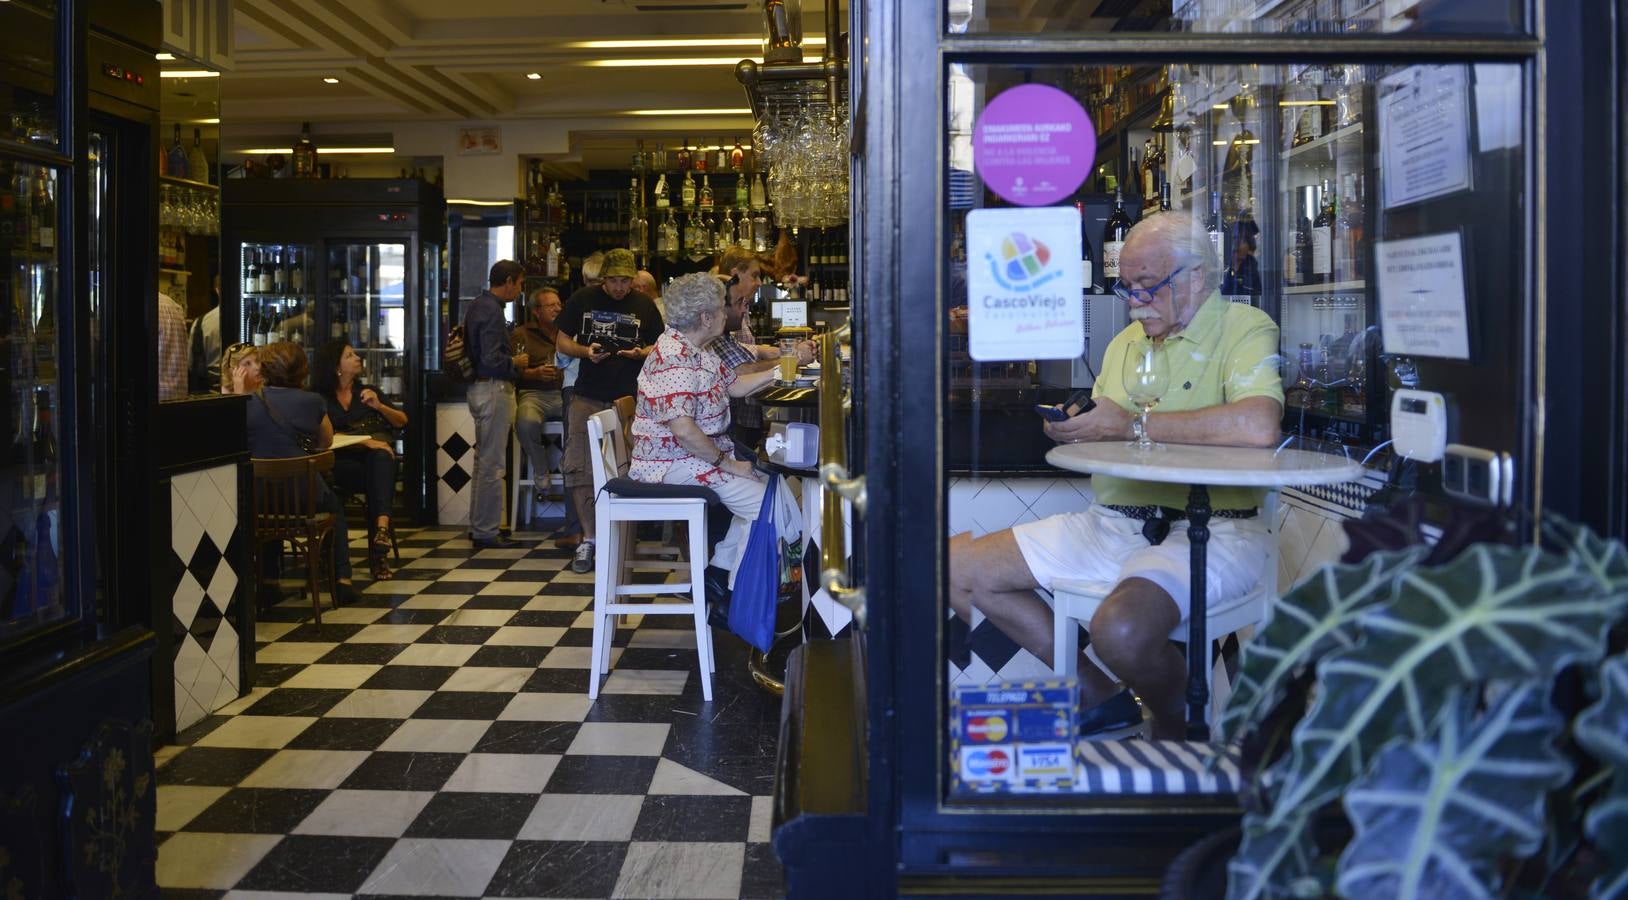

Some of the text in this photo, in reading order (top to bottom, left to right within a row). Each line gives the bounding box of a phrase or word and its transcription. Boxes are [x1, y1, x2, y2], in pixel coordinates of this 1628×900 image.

[983, 295, 1066, 311] CascoViejo
[986, 691, 1028, 704] TELEPAGO
[1032, 757, 1059, 767] VISA
